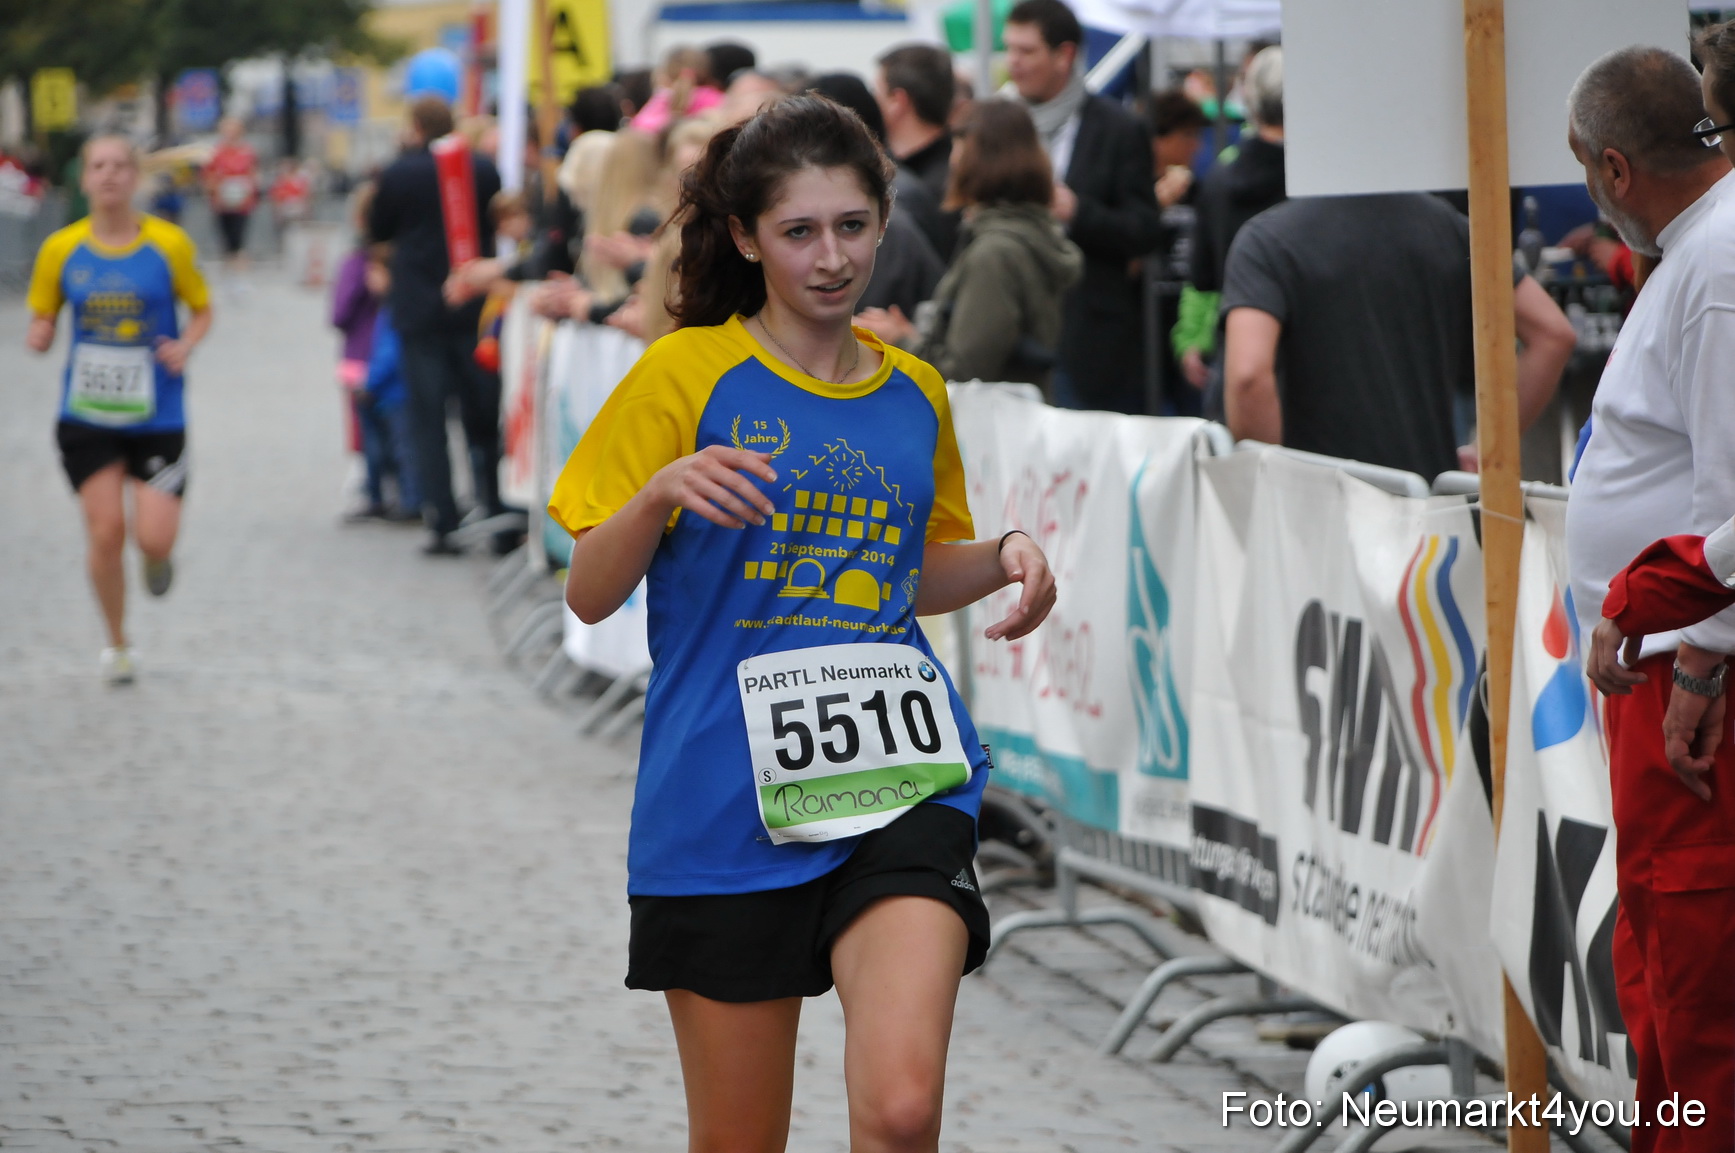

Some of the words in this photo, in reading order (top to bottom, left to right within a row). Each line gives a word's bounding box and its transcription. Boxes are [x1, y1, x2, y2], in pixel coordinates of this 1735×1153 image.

[752, 420, 767, 430] 15
[744, 434, 779, 444] Jahre
[860, 549, 896, 567] 2014
[743, 668, 817, 694] PARTL
[821, 663, 913, 683] Neumarkt
[770, 689, 942, 771] 5510
[774, 780, 923, 822] Ramona
[950, 878, 976, 892] adidas
